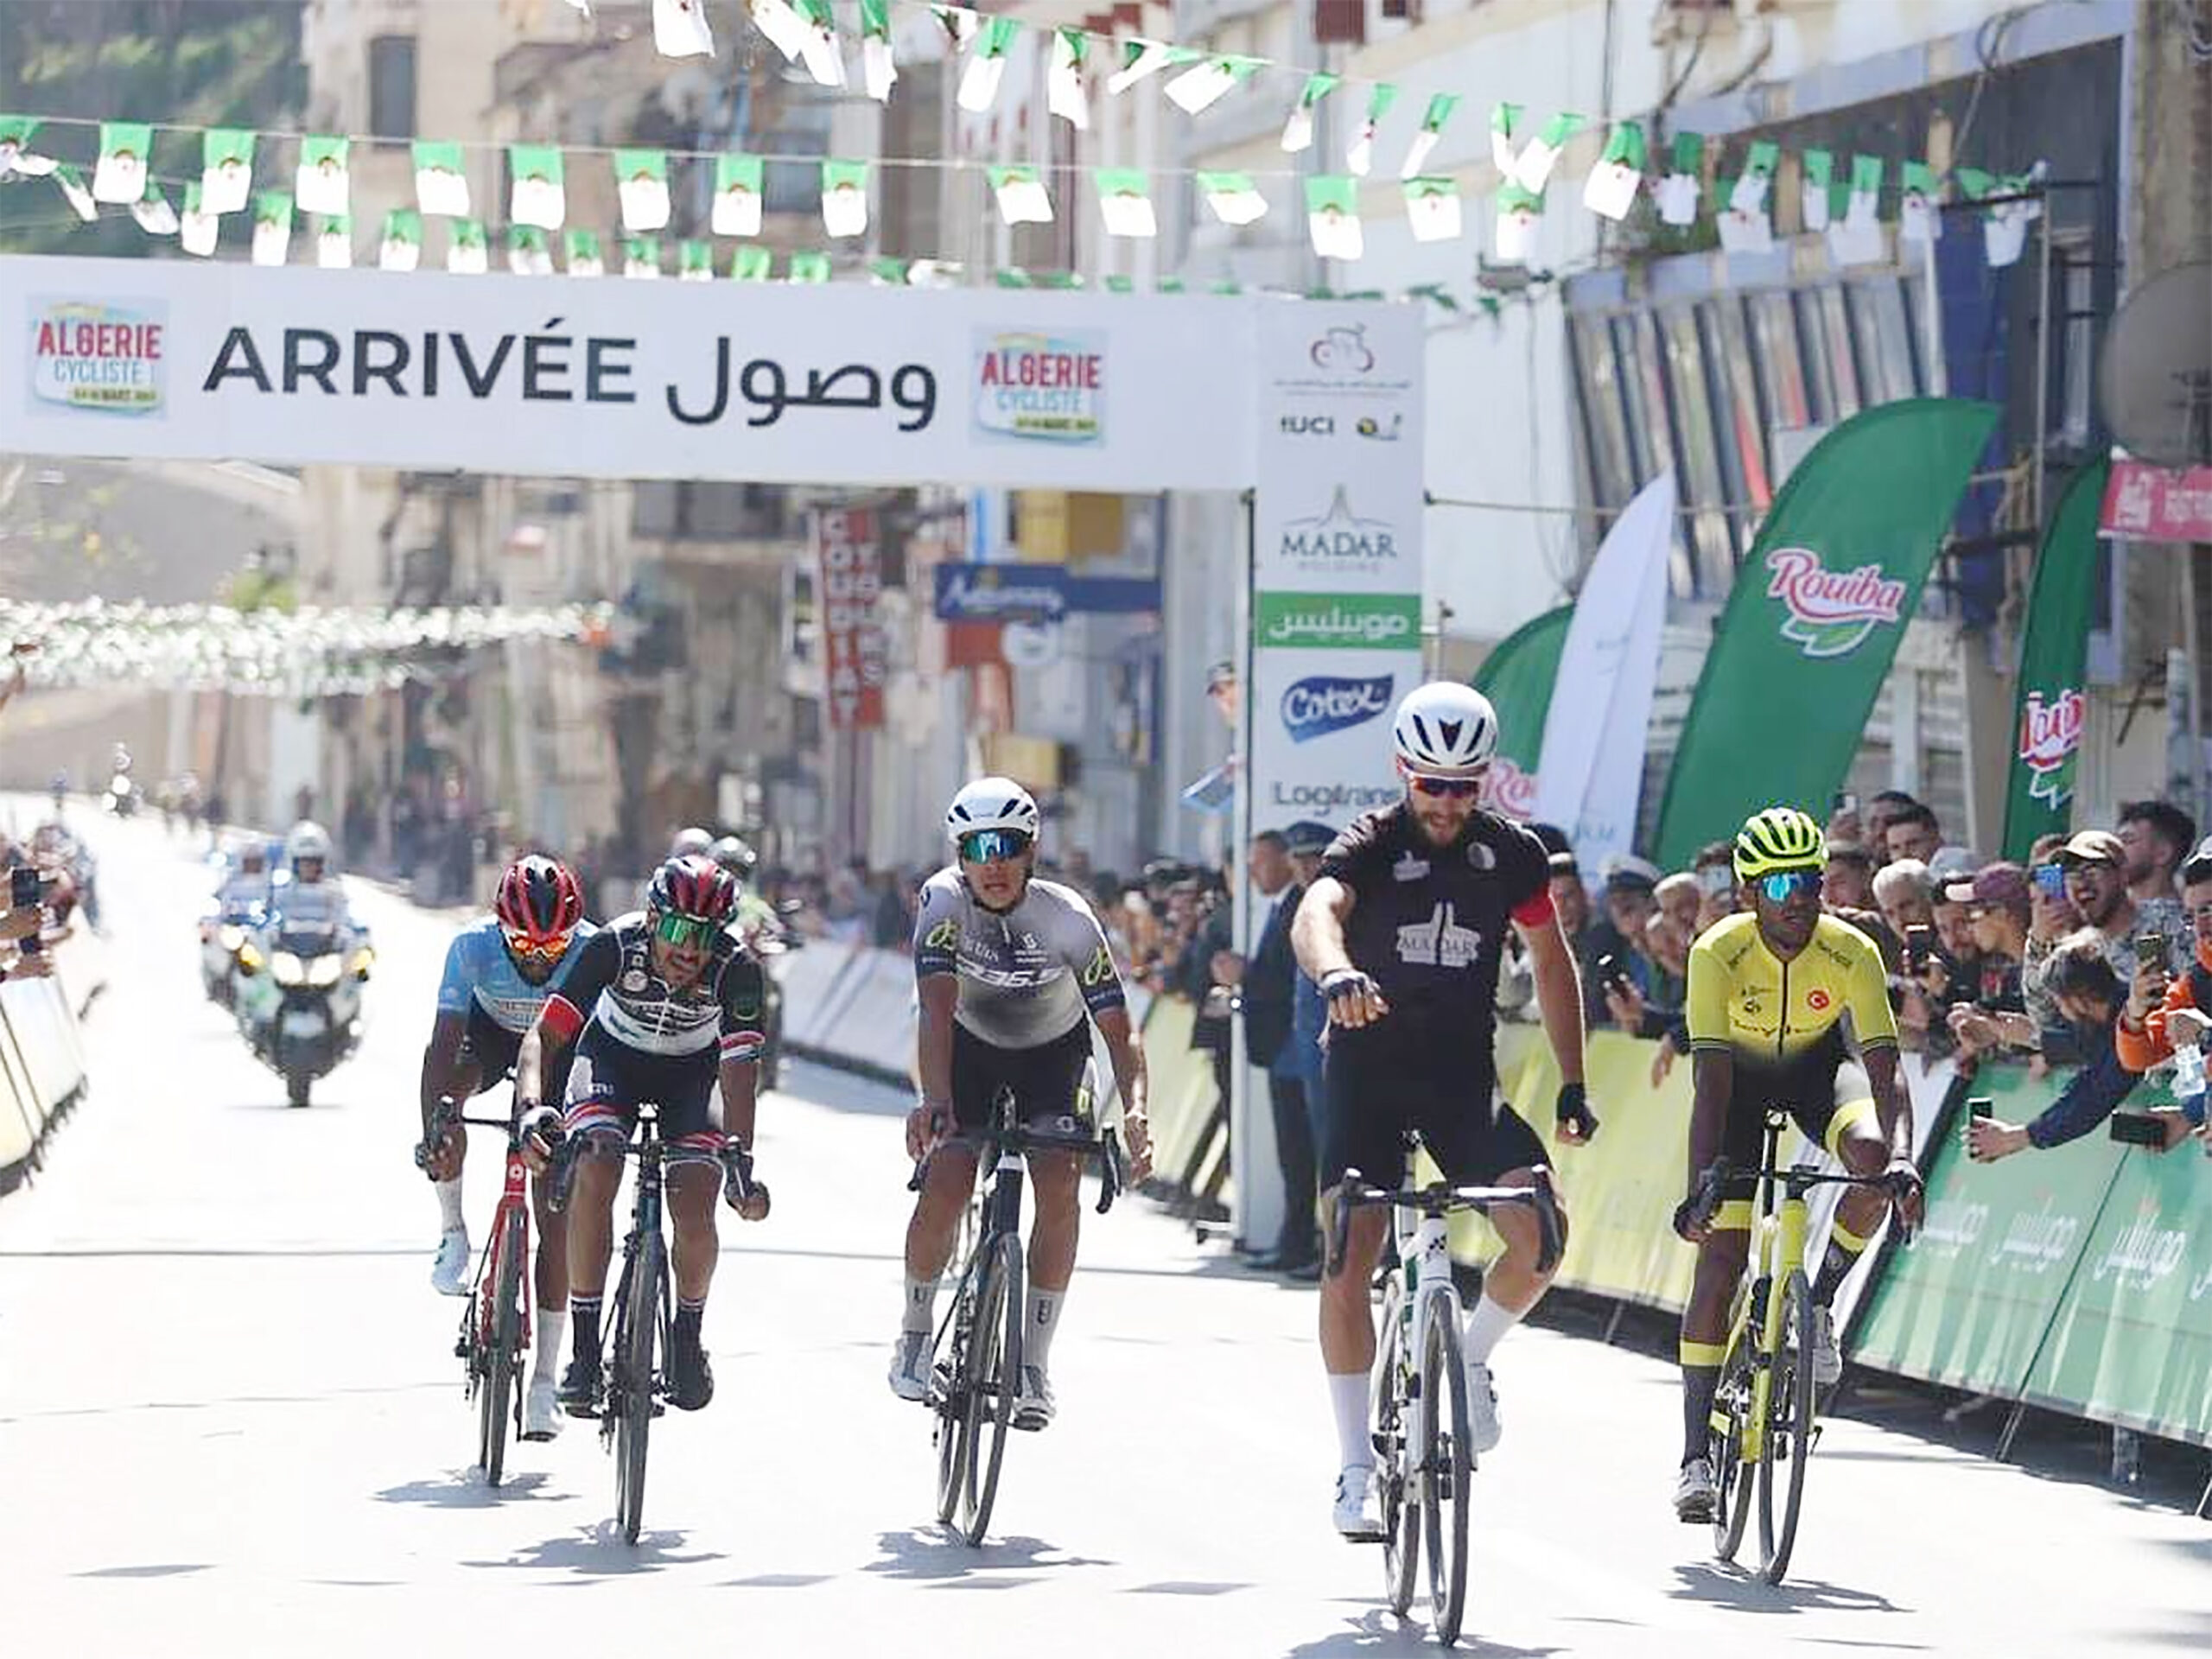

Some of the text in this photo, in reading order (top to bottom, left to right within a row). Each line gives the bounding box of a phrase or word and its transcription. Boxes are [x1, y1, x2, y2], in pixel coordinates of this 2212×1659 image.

[37, 321, 162, 359] ALGERIE
[54, 359, 143, 383] CYCLISTE
[201, 316, 637, 403] ARRIVÉE
[982, 351, 1102, 389] ALGERIE
[665, 335, 938, 433] وصول
[1281, 531, 1397, 557] MADAR
[1765, 547, 1906, 623] Rouiba
